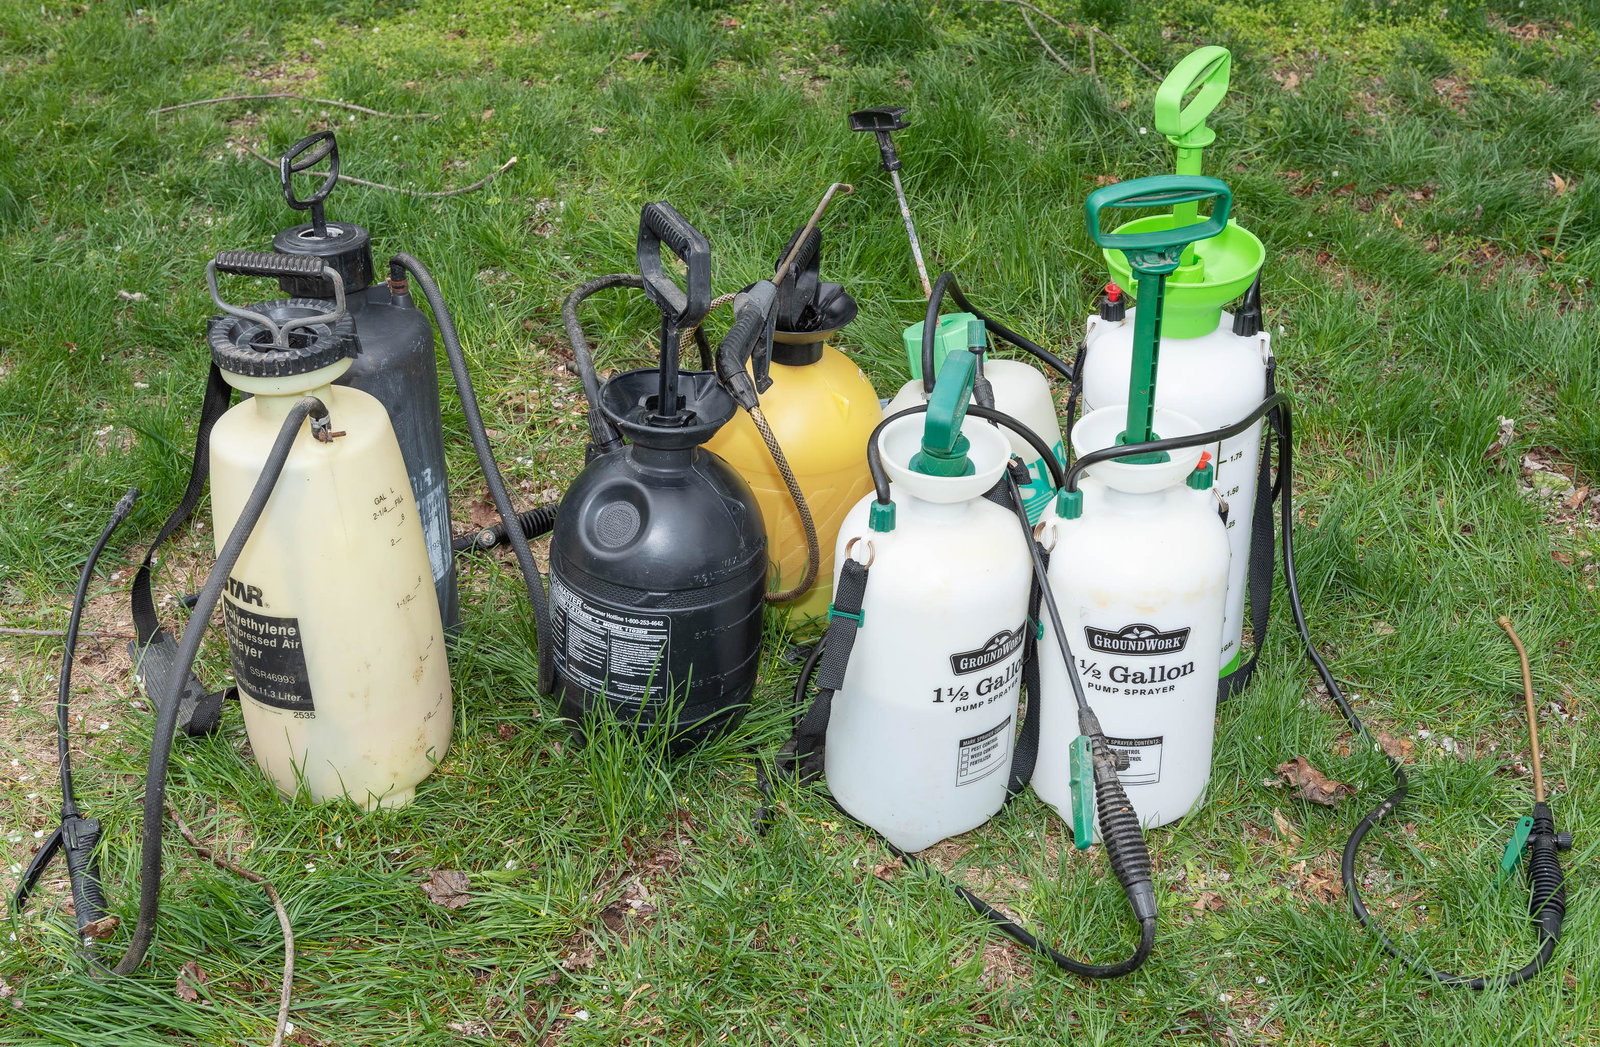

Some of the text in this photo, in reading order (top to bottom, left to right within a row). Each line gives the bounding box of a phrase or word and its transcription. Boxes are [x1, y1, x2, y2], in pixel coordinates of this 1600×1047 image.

[1230, 451, 1243, 462] 1.75
[1227, 486, 1239, 497] 1.50
[374, 494, 387, 505] GAL
[1226, 519, 1236, 530] .25
[391, 538, 396, 546] 2
[606, 612, 624, 622] Hotline
[282, 638, 300, 649] Air
[1093, 634, 1181, 651] GROUNDWORK
[249, 665, 296, 685] SSR46993
[976, 658, 1022, 697] Gallo
[1108, 661, 1195, 684] Gallon
[1087, 682, 1175, 695] PUMP SPRAYER
[955, 677, 1018, 713] PUMP SPRAYER
[293, 711, 316, 720] 2535
